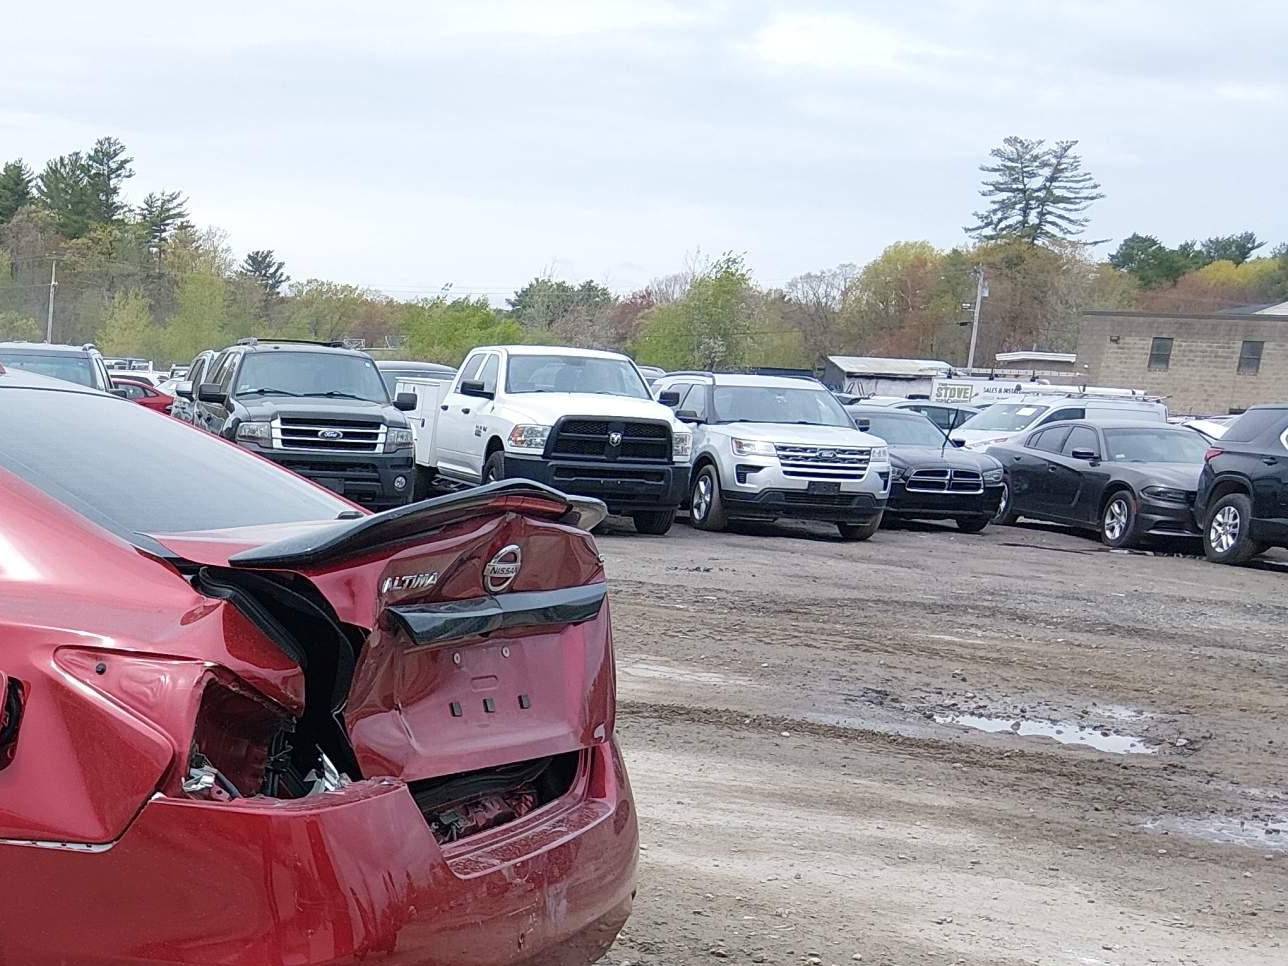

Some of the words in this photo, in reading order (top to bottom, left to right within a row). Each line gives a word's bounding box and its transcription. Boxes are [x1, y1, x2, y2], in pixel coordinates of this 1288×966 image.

[936, 386, 970, 399] STOVE
[489, 566, 518, 575] NISSAN
[381, 572, 438, 593] ALTIMA
